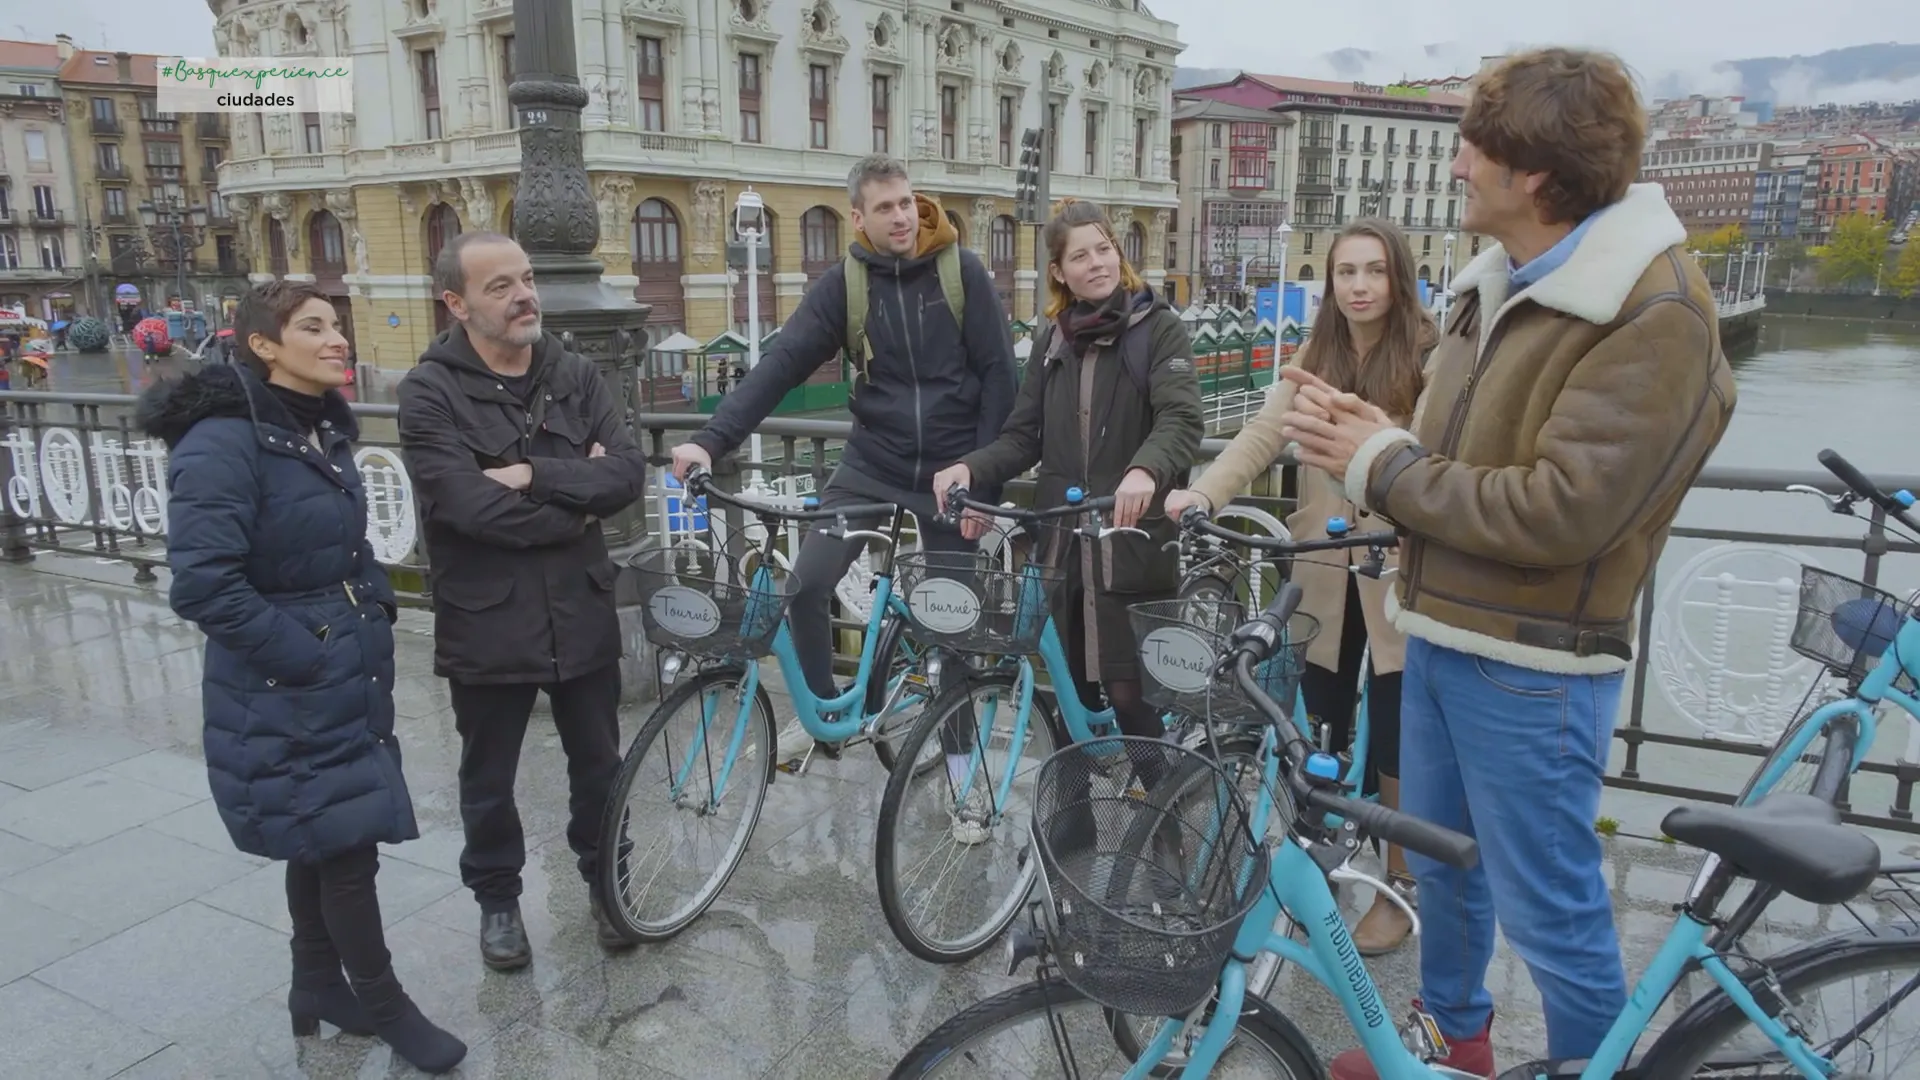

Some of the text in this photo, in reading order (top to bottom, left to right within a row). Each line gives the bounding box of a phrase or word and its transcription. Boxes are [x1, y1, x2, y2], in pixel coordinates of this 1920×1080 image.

[655, 595, 711, 622] Tourné
[914, 590, 971, 614] Tourné
[1148, 638, 1207, 673] Tourné
